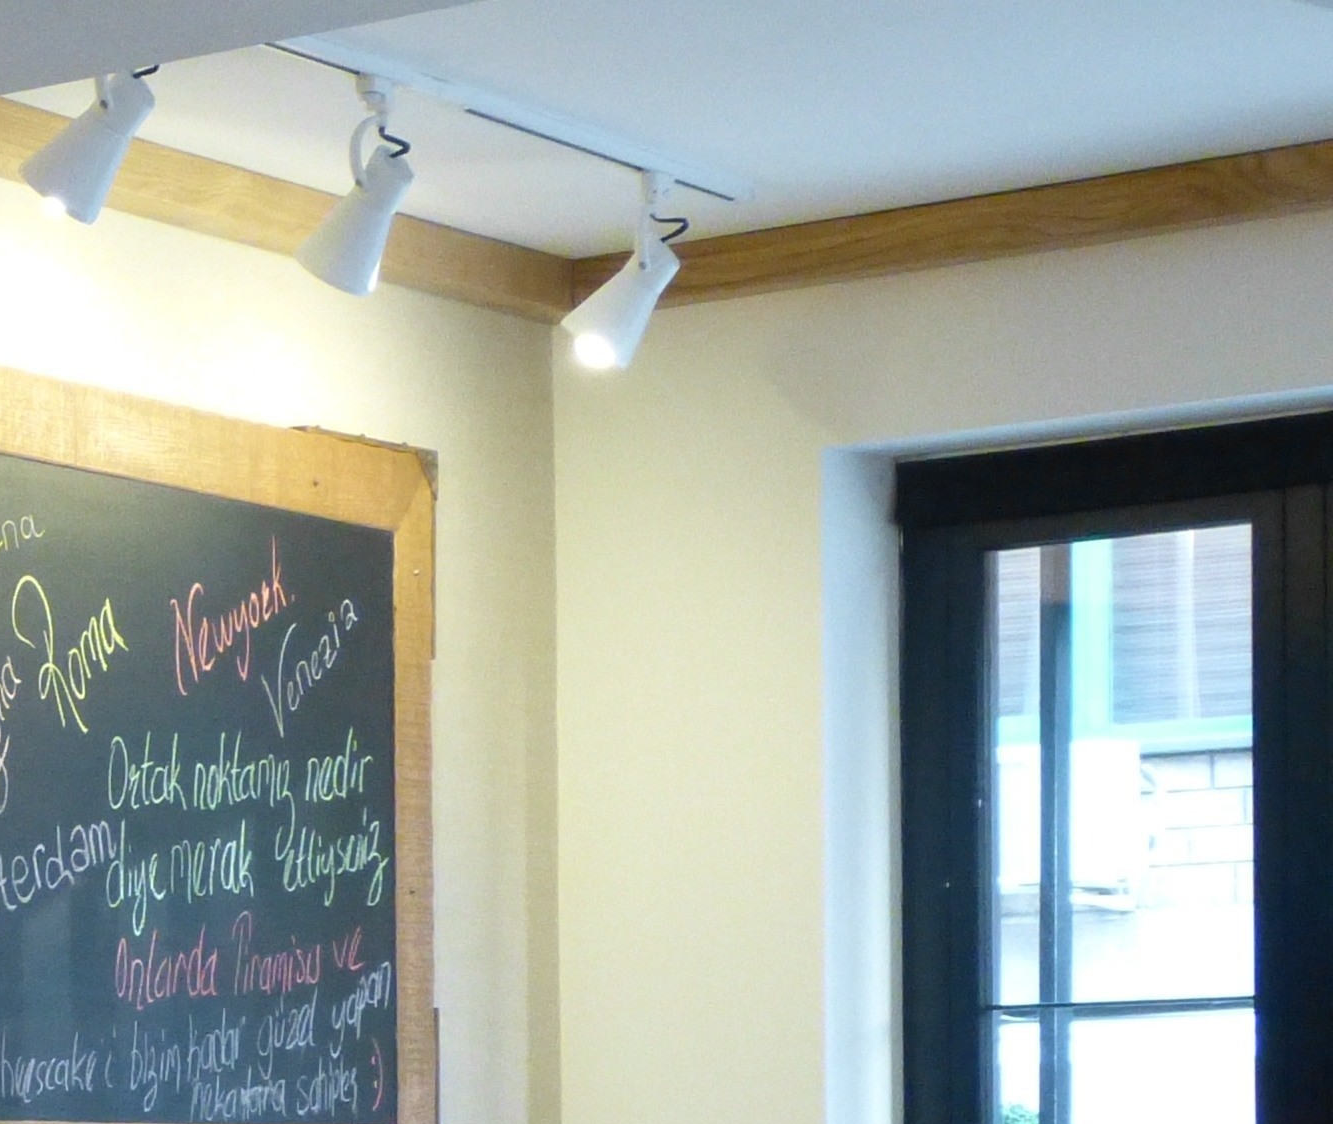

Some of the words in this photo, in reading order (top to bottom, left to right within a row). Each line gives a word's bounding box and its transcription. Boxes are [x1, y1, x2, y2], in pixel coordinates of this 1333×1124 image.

[13, 575, 130, 735] Roma
[261, 598, 359, 738] Venezia
[108, 731, 188, 810] Ortak
[306, 726, 374, 803] nedir
[106, 819, 167, 937] diye
[170, 819, 255, 904] merak
[332, 926, 365, 971] ve
